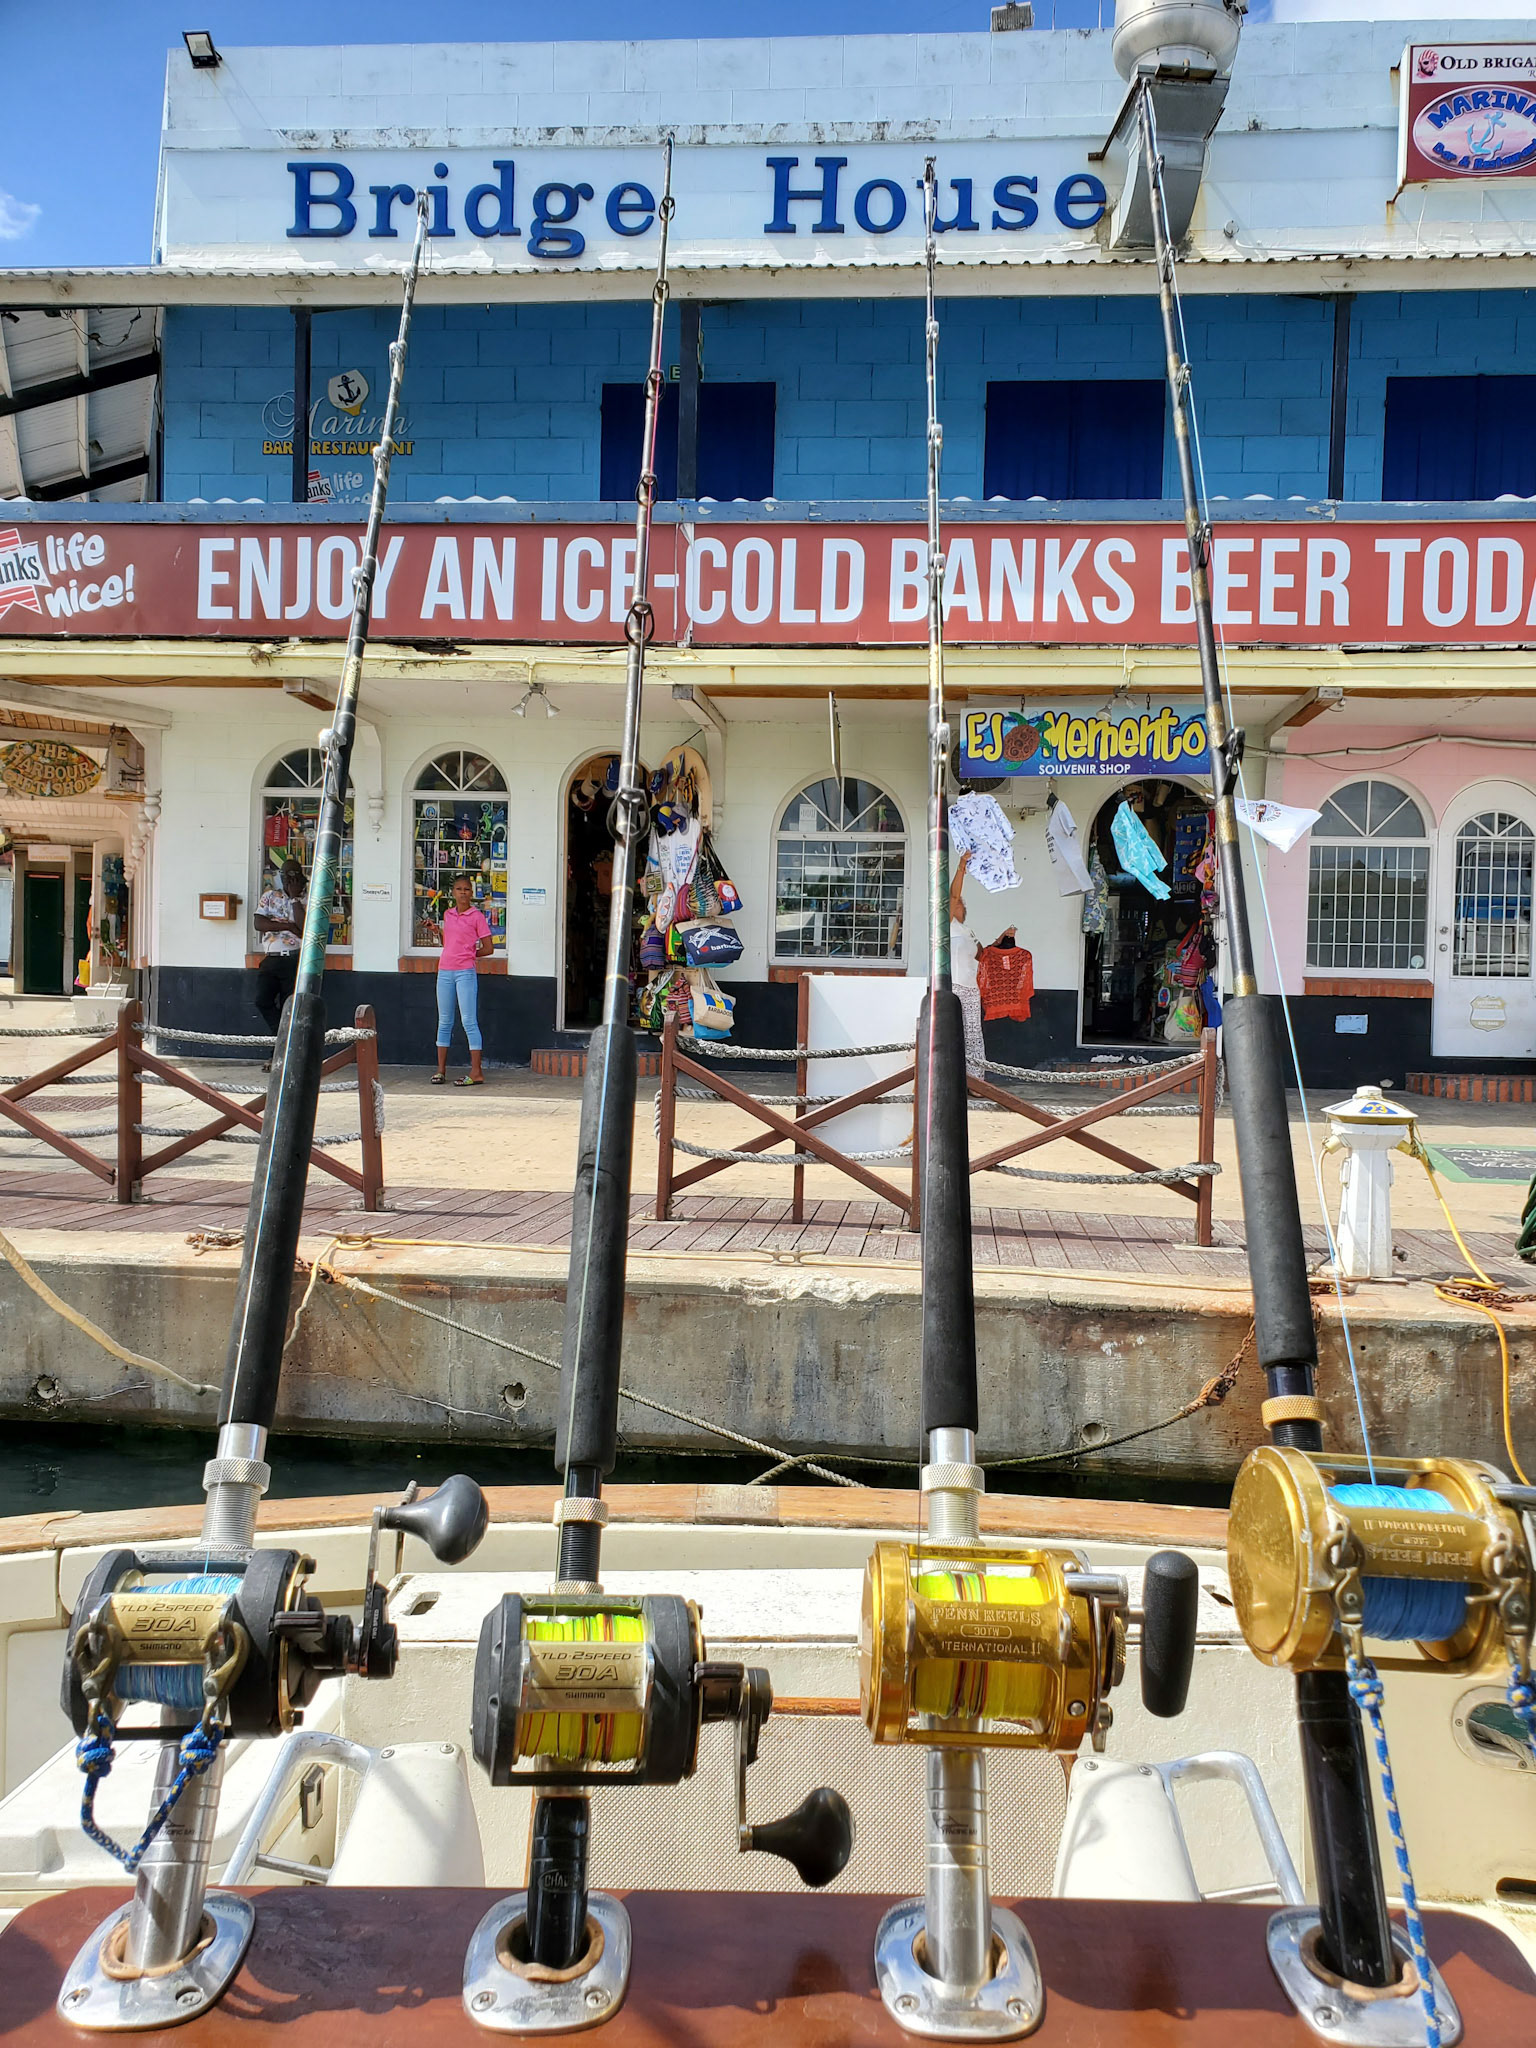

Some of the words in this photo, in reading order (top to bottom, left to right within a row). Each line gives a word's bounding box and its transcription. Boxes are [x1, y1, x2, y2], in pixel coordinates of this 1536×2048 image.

[1441, 56, 1478, 70] OLD
[1483, 57, 1536, 69] BRIGA
[1432, 141, 1457, 162] Bar
[1459, 156, 1470, 168] &
[287, 160, 656, 258] Bridge
[764, 157, 1107, 234] House
[262, 441, 294, 455] BAR
[308, 481, 331, 498] anks
[333, 471, 364, 492] life
[46, 532, 105, 575] life
[45, 563, 135, 618] nice!
[197, 535, 404, 620] ENJOY
[420, 536, 517, 620] AN
[888, 537, 1136, 624] BANKS
[1160, 537, 1351, 627] BEER
[1375, 537, 1536, 628] TOD
[966, 711, 1003, 762] EJ
[1043, 706, 1207, 762] Memento
[33, 742, 69, 760] THE
[8, 748, 90, 780] HARBOUR
[1039, 763, 1097, 775] SOUVENIR
[1099, 763, 1132, 774] SHOP
[51, 775, 93, 797] SHOP
[1365, 1103, 1388, 1114] 23
[131, 1617, 198, 1632] 30A
[930, 1607, 980, 1623] PENN
[984, 1608, 1042, 1627] REELS
[556, 1664, 618, 1680] 30A
